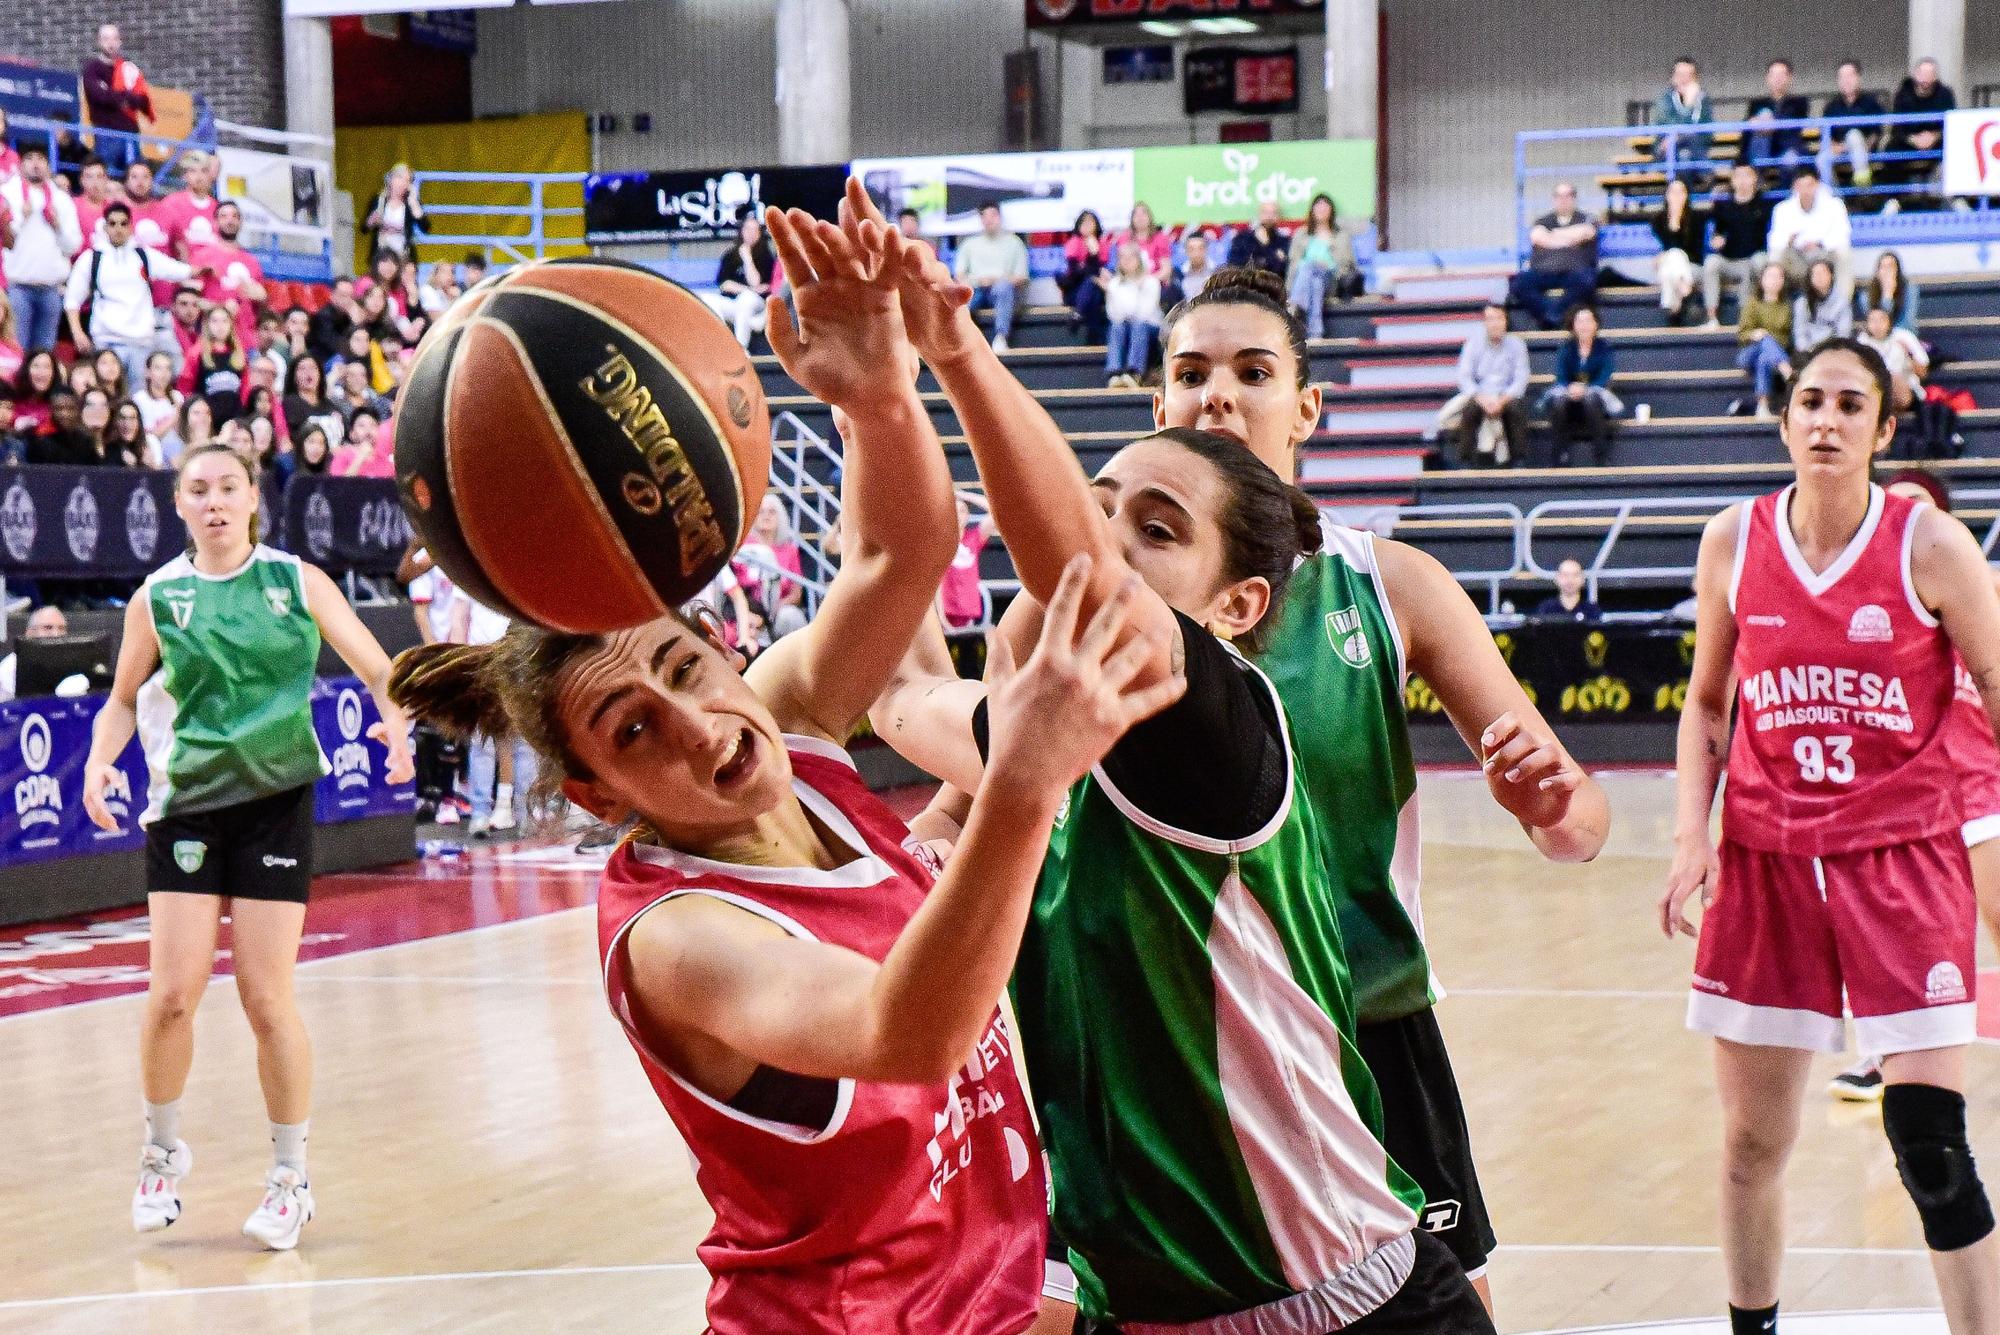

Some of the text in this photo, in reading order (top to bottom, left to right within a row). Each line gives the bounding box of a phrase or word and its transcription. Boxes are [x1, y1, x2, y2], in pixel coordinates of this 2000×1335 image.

[1186, 171, 1251, 207] brot
[1743, 665, 1910, 713] MANRESA
[1793, 735, 1856, 785] 93
